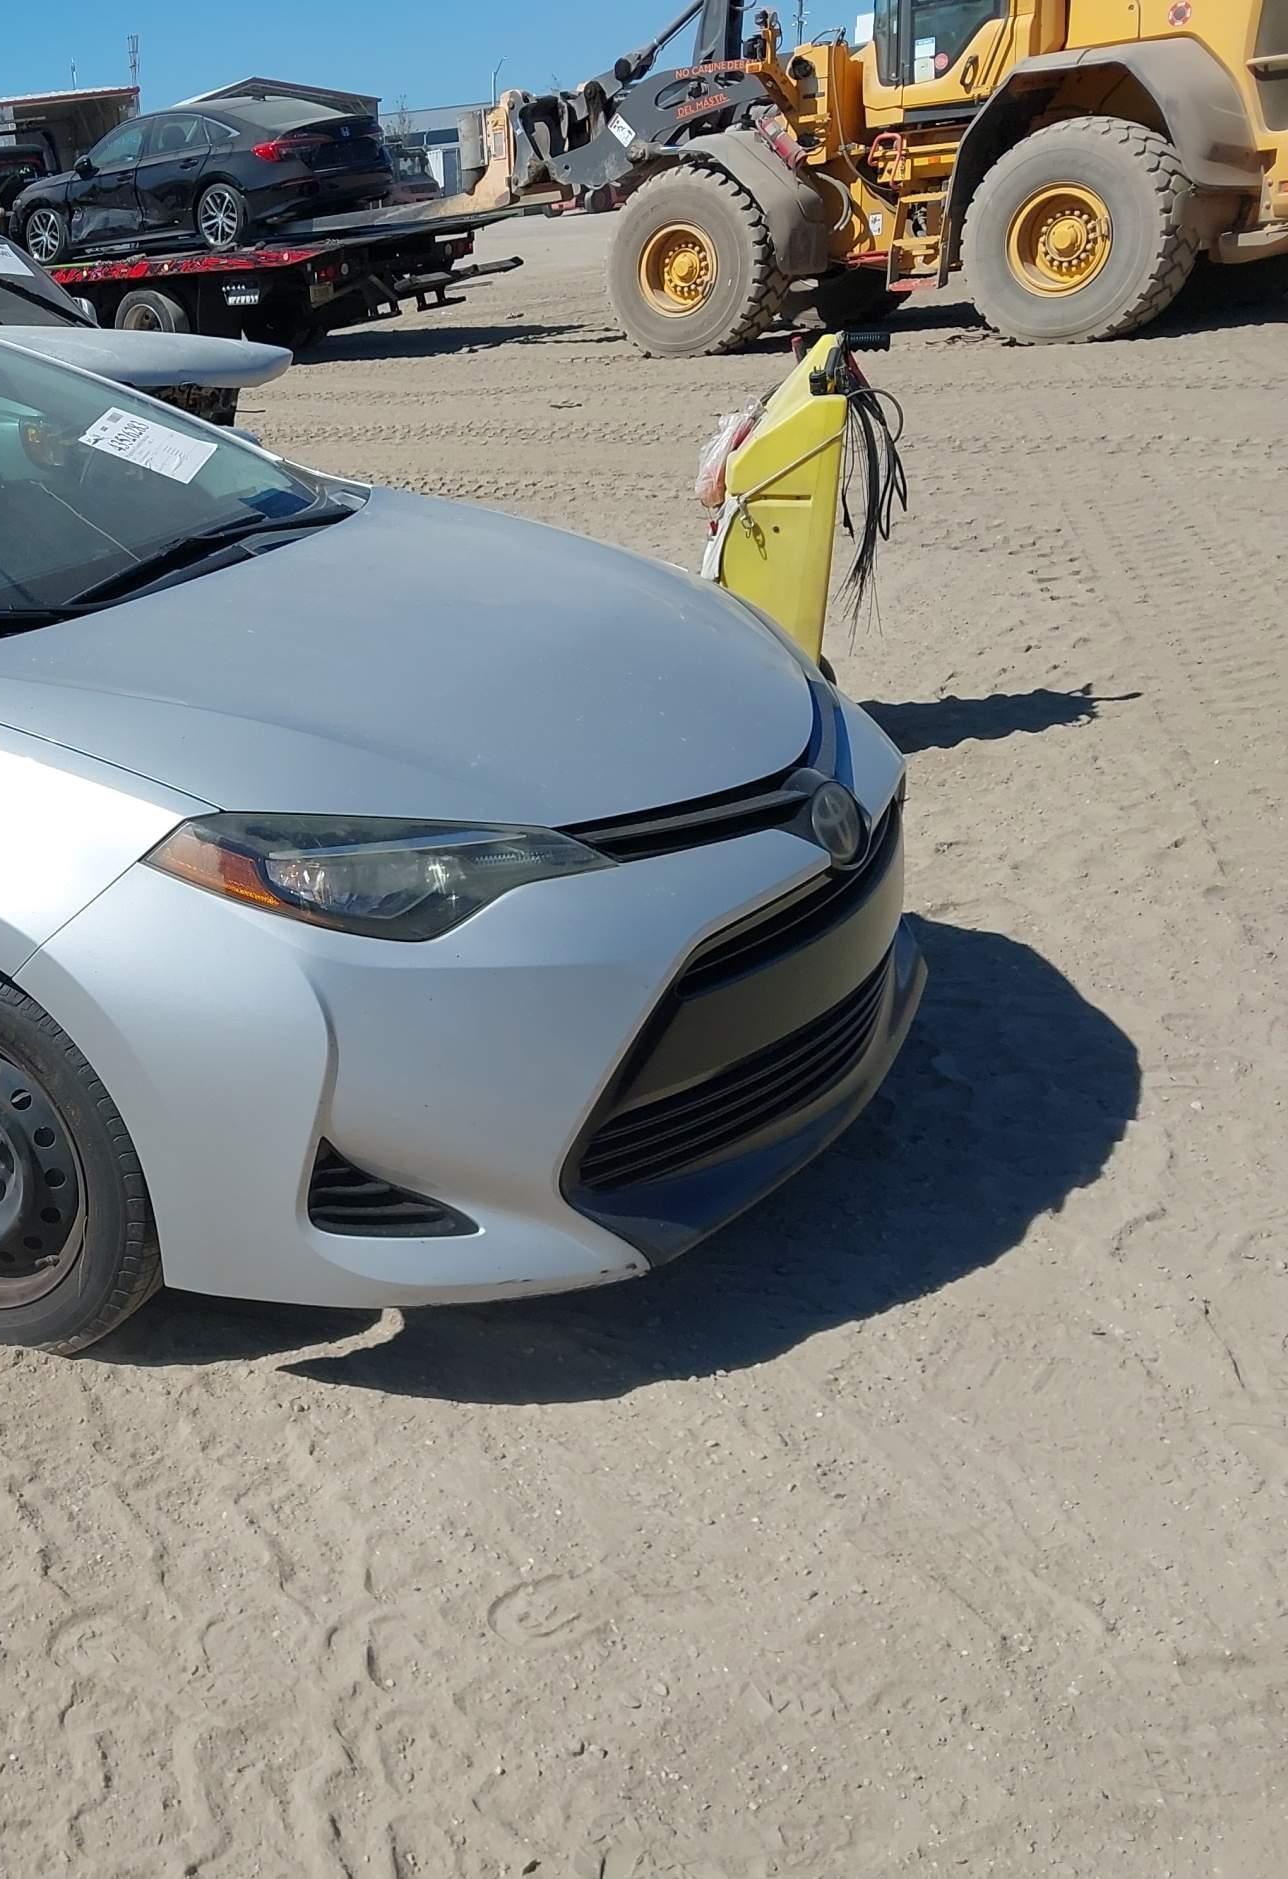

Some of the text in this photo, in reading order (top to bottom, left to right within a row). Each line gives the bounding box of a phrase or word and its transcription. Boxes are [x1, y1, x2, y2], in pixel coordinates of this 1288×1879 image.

[675, 68, 690, 80] NO
[692, 62, 726, 75] CAMINE
[677, 104, 696, 118] DEL
[108, 419, 150, 452] 43526283
